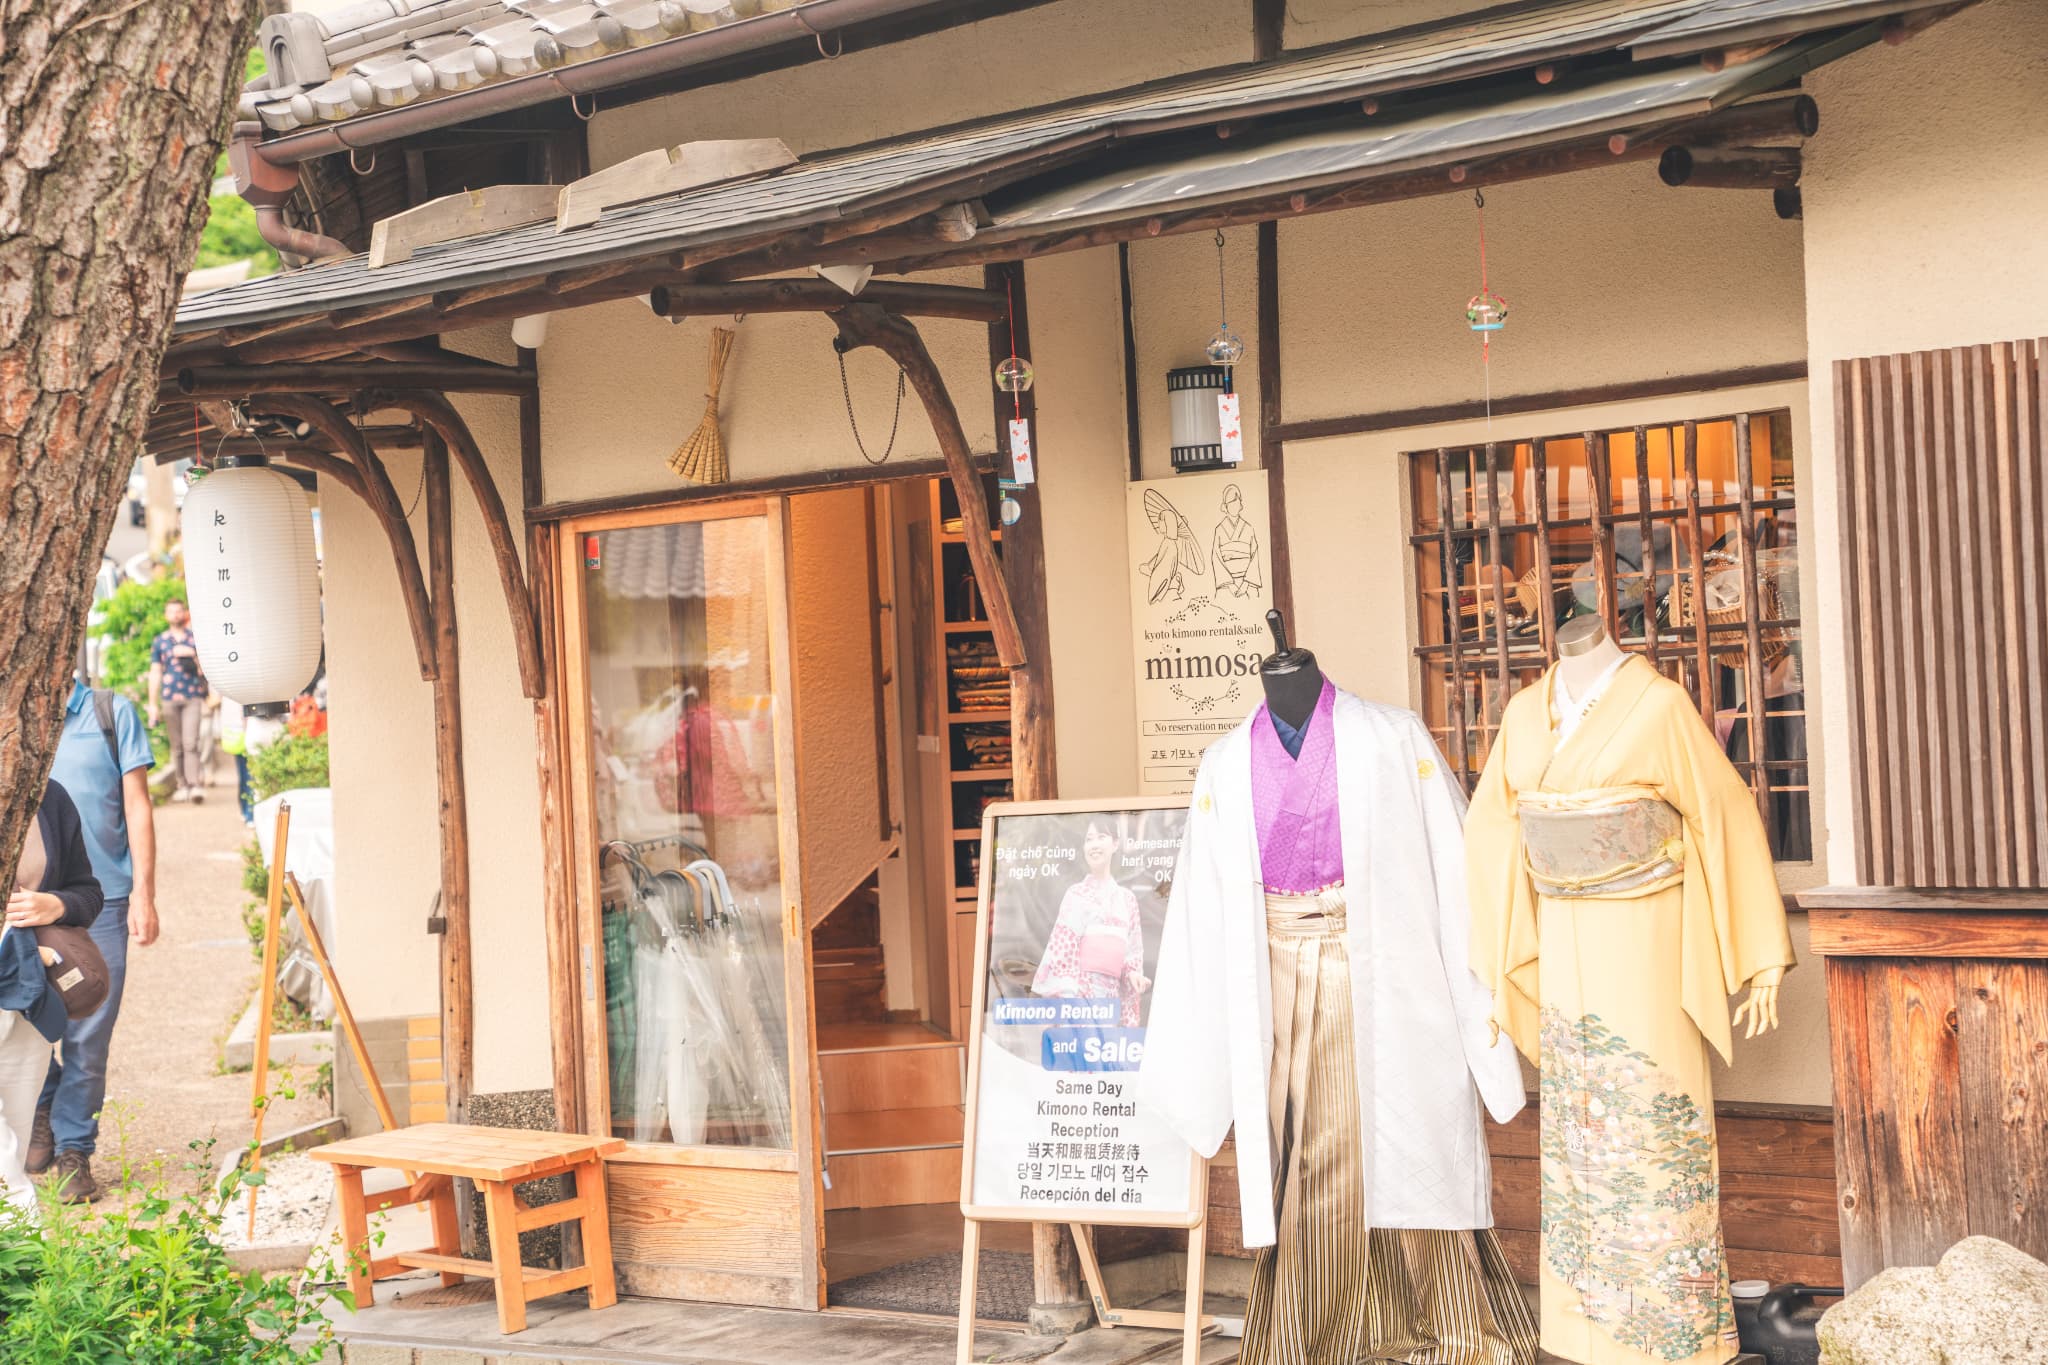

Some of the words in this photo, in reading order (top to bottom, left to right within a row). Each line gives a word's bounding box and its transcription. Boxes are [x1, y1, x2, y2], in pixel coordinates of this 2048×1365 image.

[214, 509, 239, 663] kimono
[1144, 628, 1170, 642] kyoto
[1171, 626, 1207, 639] kimono
[1209, 624, 1263, 637] rental&sale
[1145, 647, 1263, 680] mimosa
[1154, 722, 1167, 733] No
[1168, 721, 1216, 732] reservation
[1151, 749, 1168, 760] 교토
[1170, 748, 1196, 760] 기모노
[996, 847, 1017, 863] Đặt
[1121, 855, 1144, 867] hari
[1146, 856, 1174, 869] yang
[1009, 865, 1037, 880] ngày
[1041, 863, 1060, 876] OK
[1154, 870, 1172, 883] OK
[995, 1003, 1056, 1020] Kimono
[1060, 1003, 1114, 1019] Rental
[1052, 1039, 1077, 1053] and
[1083, 1036, 1145, 1063] Sale
[1056, 1079, 1093, 1095] Same
[1097, 1081, 1123, 1098] Day
[1037, 1101, 1088, 1117] Kimono
[1093, 1102, 1136, 1117] Rental
[1051, 1122, 1119, 1140] Reception
[1027, 1142, 1140, 1161] 当天和服租赁接待
[1017, 1162, 1042, 1180] 당일
[1047, 1164, 1086, 1181] 기모노
[1090, 1164, 1116, 1182] 대여
[1121, 1165, 1149, 1184] 접수
[1020, 1185, 1090, 1204] Recepción
[1094, 1187, 1116, 1203] del
[1121, 1187, 1142, 1204] día
